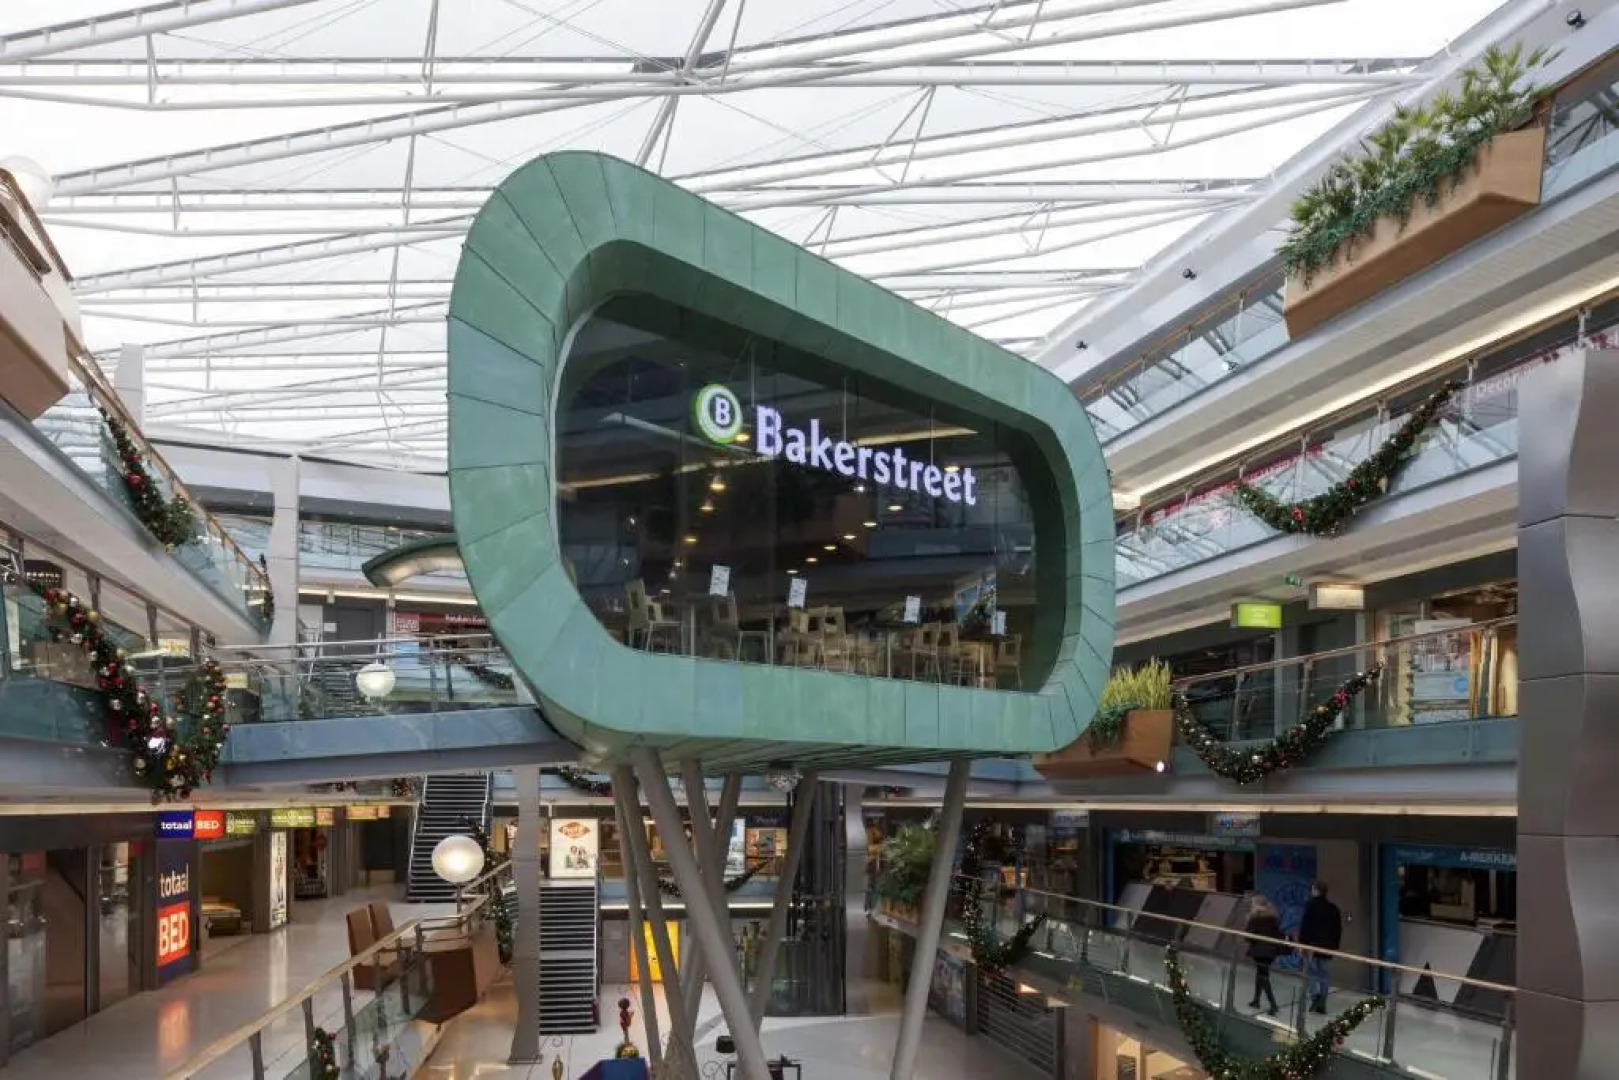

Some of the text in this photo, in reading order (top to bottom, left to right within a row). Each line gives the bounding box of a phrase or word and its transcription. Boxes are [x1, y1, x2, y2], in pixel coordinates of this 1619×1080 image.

[715, 397, 730, 425] B
[756, 405, 976, 506] Bakerstreet
[161, 820, 219, 830] totaal BED
[159, 863, 188, 898] totaal
[159, 911, 189, 957] BED
